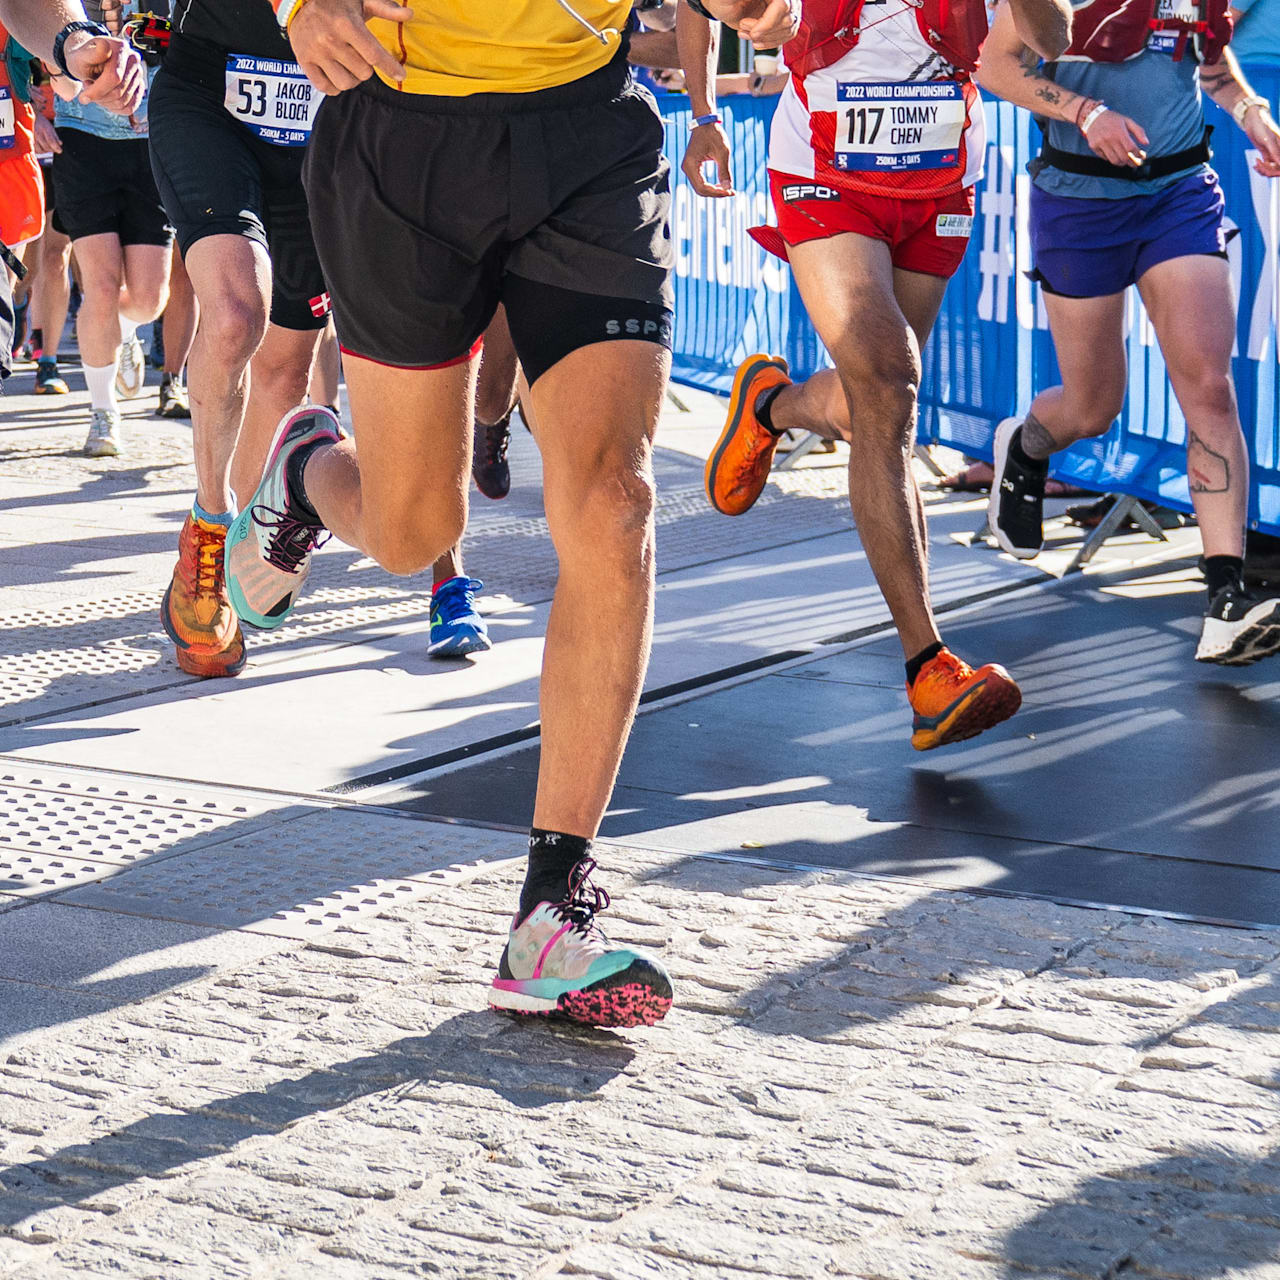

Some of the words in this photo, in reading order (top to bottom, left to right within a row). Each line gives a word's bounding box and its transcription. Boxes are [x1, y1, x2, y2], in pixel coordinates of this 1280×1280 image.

[236, 58, 255, 70] 2022
[256, 60, 282, 74] WORLD
[236, 78, 267, 117] 53
[275, 81, 312, 101] JAKOB
[845, 85, 865, 98] 2022
[865, 85, 892, 98] WORLD
[894, 84, 955, 98] CHAMPIONSHIPS
[275, 101, 309, 121] BLOCH
[845, 108, 885, 145] 117
[890, 106, 939, 124] TOMMY
[259, 127, 280, 139] 250KM
[285, 131, 290, 140] 5
[290, 132, 305, 142] DAYS
[890, 127, 923, 145] CHEN
[907, 154, 920, 165] DAYS
